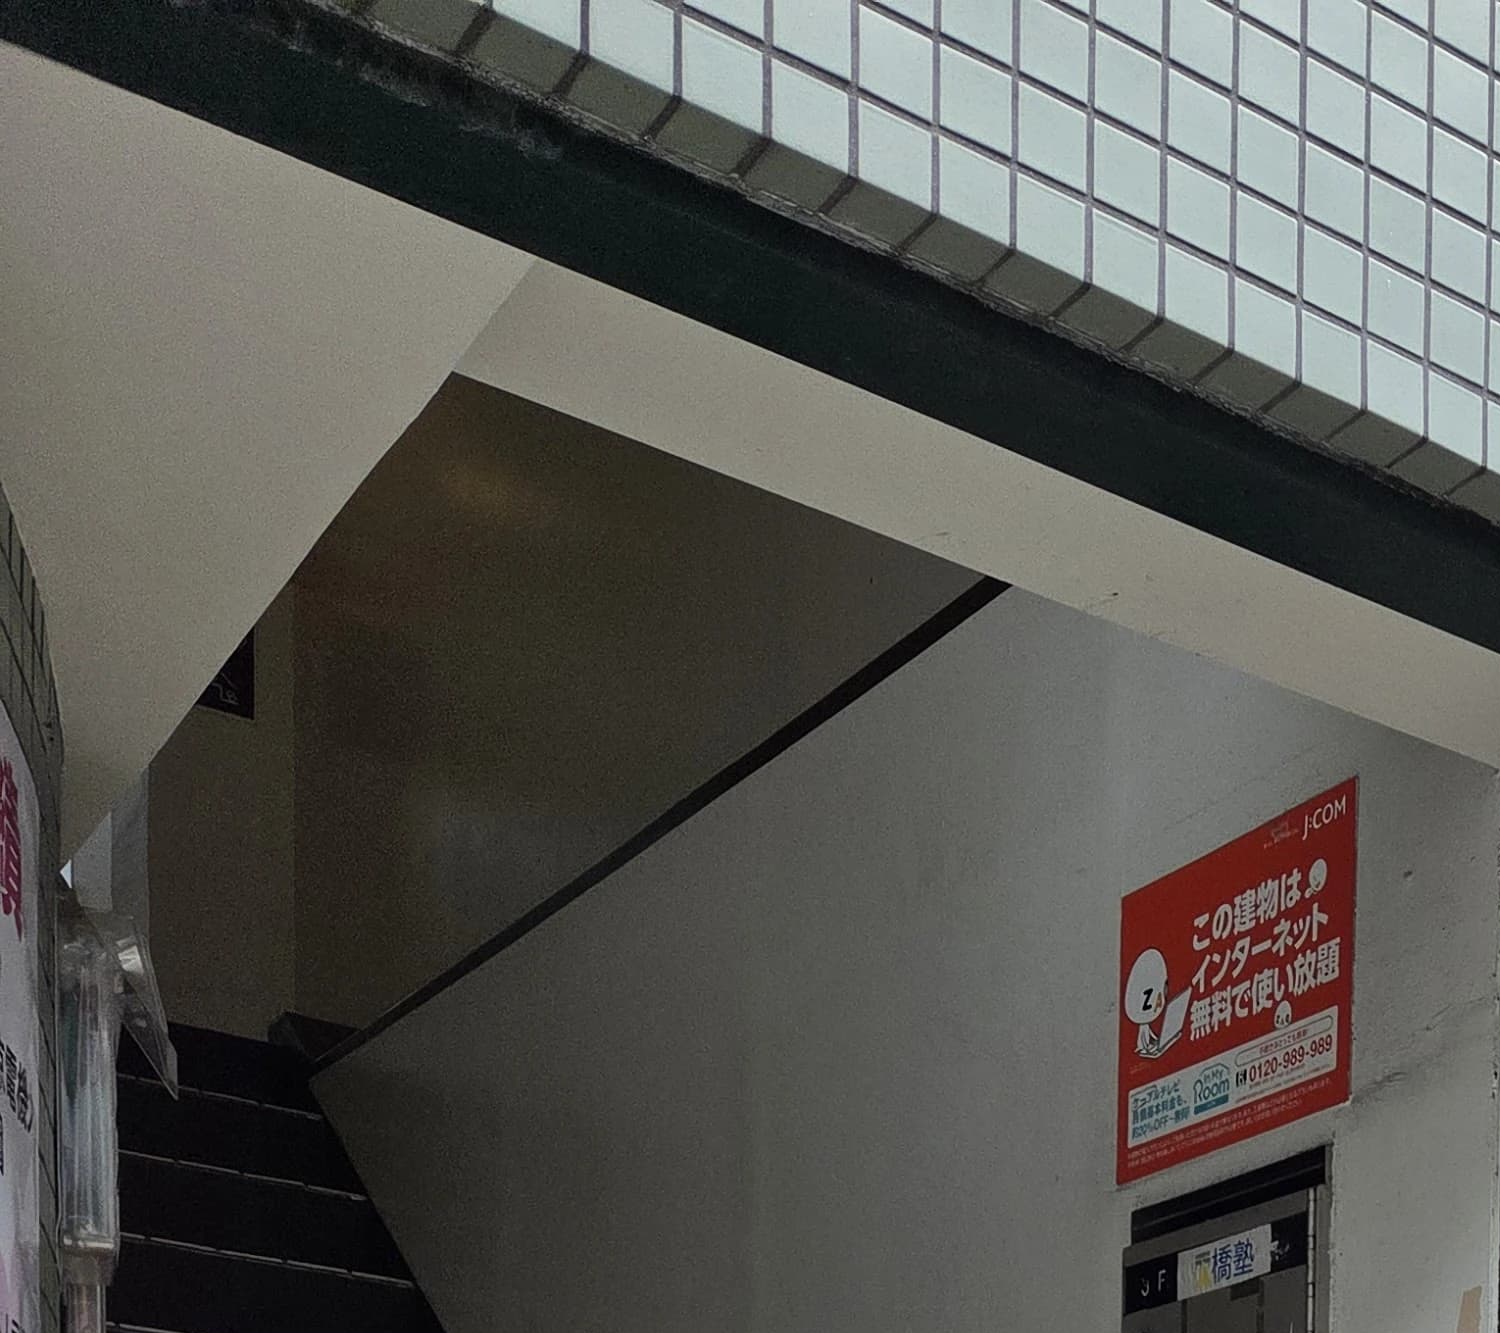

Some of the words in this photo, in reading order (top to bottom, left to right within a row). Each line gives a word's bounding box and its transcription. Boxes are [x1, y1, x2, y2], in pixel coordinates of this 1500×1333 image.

[1301, 795, 1346, 840] J:COM
[1192, 869, 1302, 950] この建物は
[1192, 902, 1328, 993] インターネット
[1189, 937, 1340, 1042] 無料で使い放題
[1248, 1034, 1332, 1084] 0120-989-989
